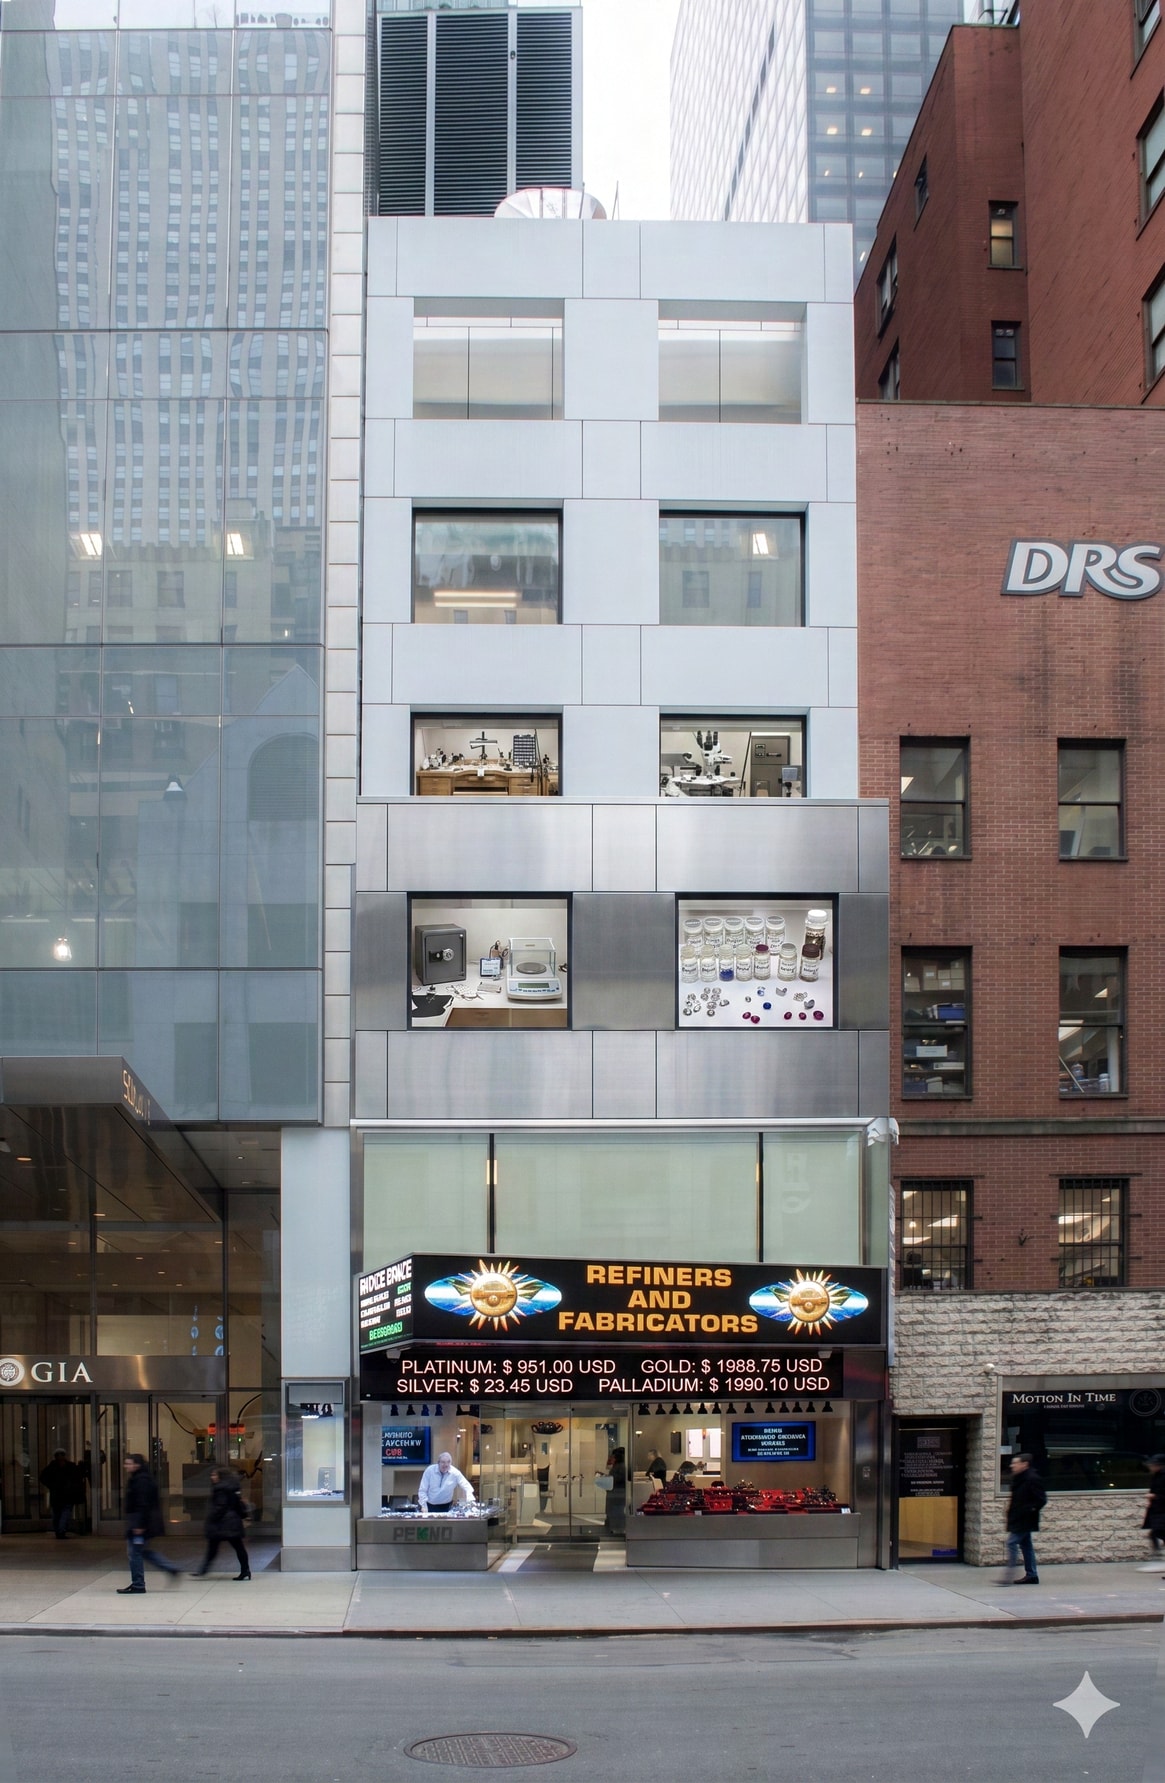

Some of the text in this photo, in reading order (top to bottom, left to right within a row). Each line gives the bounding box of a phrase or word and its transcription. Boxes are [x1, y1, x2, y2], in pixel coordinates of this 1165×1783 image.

[1003, 540, 1163, 598] DRS
[586, 1263, 732, 1287] REFINERS
[627, 1289, 691, 1309] AND
[558, 1311, 758, 1333] FABRICATORS
[31, 1361, 94, 1383] GIA
[402, 1359, 616, 1376] PLATINUM: $ 951.00 USD
[640, 1358, 823, 1375] GOLD: $ 1988.75 USD
[396, 1378, 573, 1395] SILVER: $ 23.45 USD
[598, 1376, 830, 1393] PALLADIUM: $ 1990.10 USD
[1012, 1392, 1117, 1404] MOTION IN TIME
